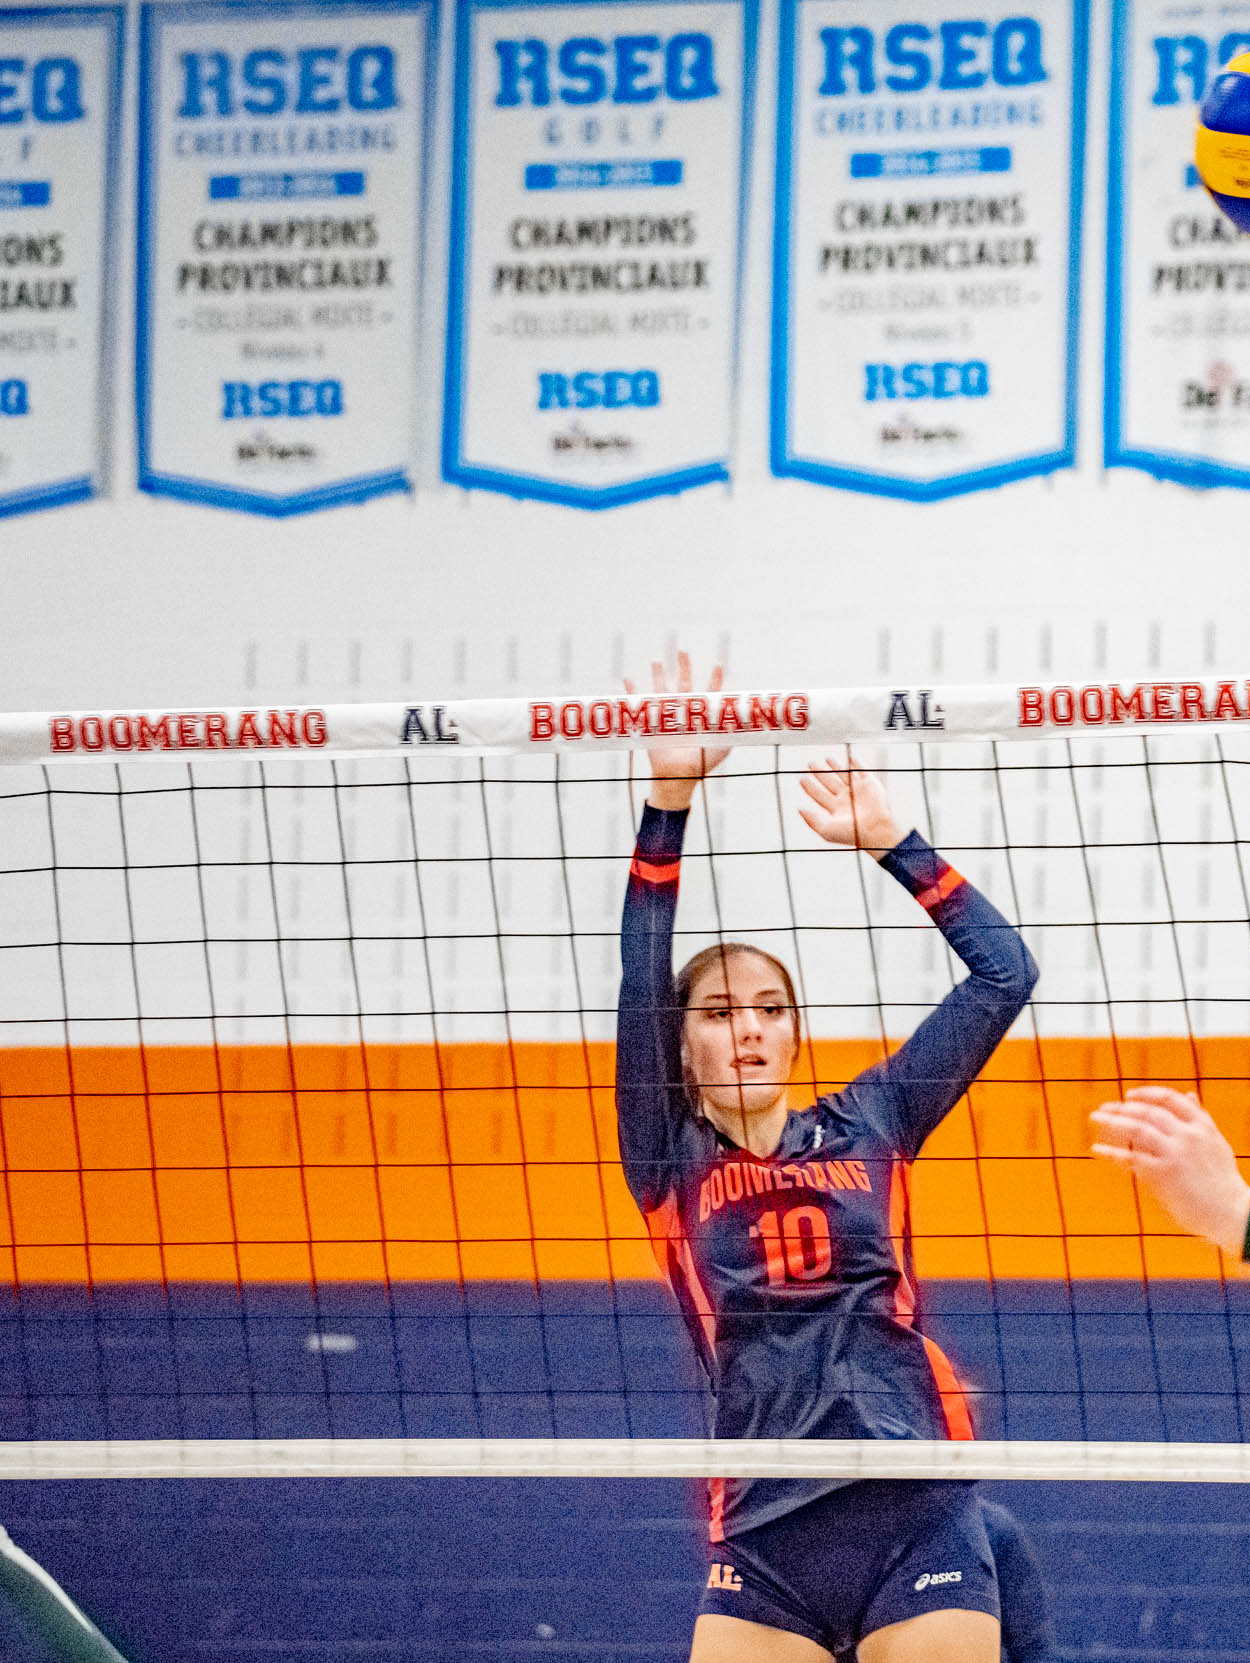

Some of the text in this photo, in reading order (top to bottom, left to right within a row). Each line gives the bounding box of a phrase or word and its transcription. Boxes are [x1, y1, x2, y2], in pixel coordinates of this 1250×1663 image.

[494, 32, 719, 107] RSEQ
[818, 17, 1048, 96] RSEQ
[179, 45, 398, 118] RSEQ
[815, 98, 1044, 135] CHEERLEADING
[174, 122, 397, 157] CHEERLEADING
[837, 197, 1022, 231] CHAMPIONS
[194, 216, 379, 251] CHAMPIONS
[510, 216, 693, 250] CHAMPIONS
[820, 238, 1035, 273] PROVINCIAUX
[178, 259, 388, 292] PROVINCIAUX
[493, 260, 705, 294] PROVINCIAUX
[223, 379, 343, 419] RSEQ
[538, 370, 660, 410] RSEQ
[865, 360, 989, 401] RSEQ
[49, 708, 327, 752] BOOMERANG
[529, 693, 809, 741] BOOMERANG
[749, 1205, 832, 1286] 10
[929, 1570, 962, 1586] asics
